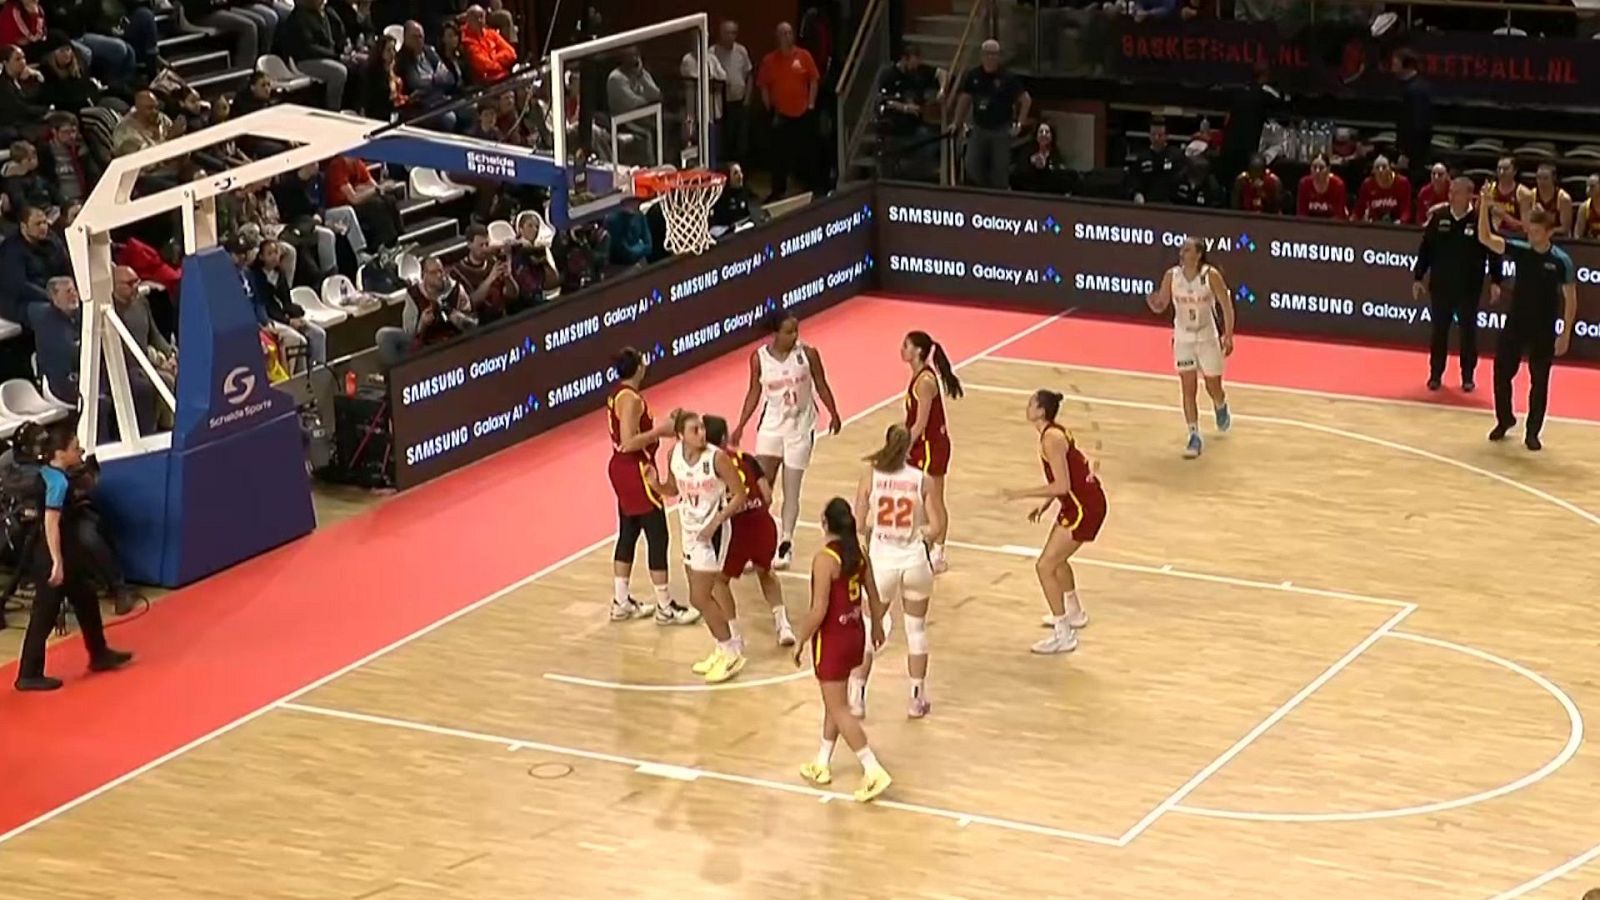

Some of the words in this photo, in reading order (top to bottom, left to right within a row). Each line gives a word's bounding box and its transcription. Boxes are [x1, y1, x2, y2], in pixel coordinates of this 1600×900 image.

[780, 227, 823, 257] SAMSUNG
[825, 217, 852, 238] Galaxy
[853, 211, 861, 225] AI
[888, 205, 965, 227] SAMSUNG
[972, 213, 1021, 236] Galaxy
[1024, 219, 1038, 233] AI
[1074, 223, 1154, 245] SAMSUNG
[1217, 237, 1231, 252] AI
[889, 255, 966, 277] SAMSUNG
[972, 263, 1022, 286] Galaxy
[1025, 269, 1039, 284] AI
[1270, 240, 1355, 263] SAMSUNG
[1362, 249, 1419, 272] Galaxy
[670, 269, 718, 302] SAMSUNG
[721, 257, 752, 281] Galaxy
[752, 252, 762, 267] AI
[782, 277, 825, 309] SAMSUNG
[827, 267, 854, 288] Galaxy
[854, 261, 862, 276] AI
[1074, 273, 1154, 295] SAMSUNG
[545, 315, 600, 351] SAMSUNG
[603, 303, 638, 328] Galaxy
[638, 297, 648, 314] AI
[1269, 292, 1354, 315] SAMSUNG
[1361, 301, 1417, 324] Galaxy
[671, 321, 720, 357] SAMSUNG
[723, 309, 754, 334] Galaxy
[754, 304, 764, 320] AI
[402, 367, 465, 405] SAMSUNG
[469, 352, 508, 380] Galaxy
[508, 346, 520, 364] AI
[547, 370, 603, 408] SAMSUNG
[406, 425, 468, 466] SAMSUNG
[473, 410, 511, 437] Galaxy
[511, 403, 523, 420] AI
[877, 496, 913, 528] 22
